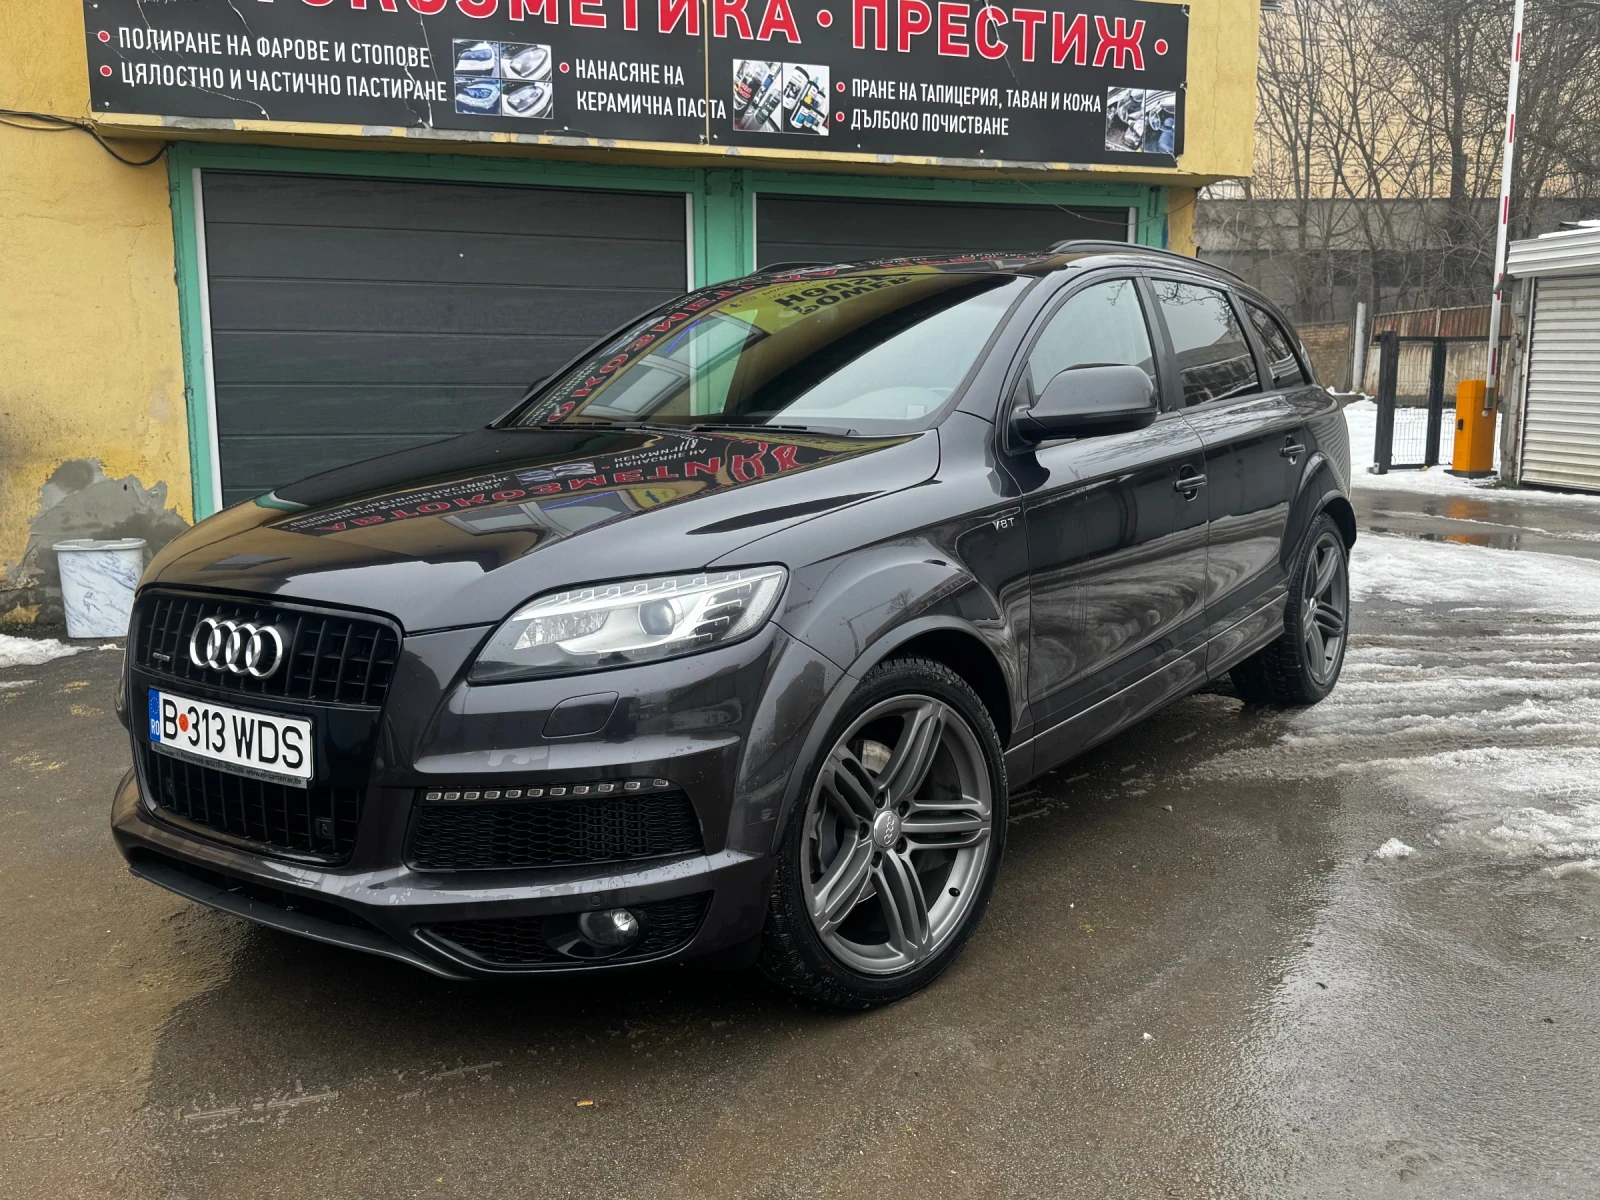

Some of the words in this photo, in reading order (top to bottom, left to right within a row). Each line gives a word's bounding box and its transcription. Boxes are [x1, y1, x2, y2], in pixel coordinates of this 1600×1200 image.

[118, 27, 221, 54] ПОЛИРАНЕ
[227, 34, 251, 56] НА
[256, 37, 329, 62] ФАРОВЕ
[333, 43, 347, 63] И
[351, 44, 430, 68] СТОПОВЕ
[852, 0, 1146, 70] ПРЕСТИЖ
[121, 62, 224, 89] ЦЯЛОСТНО
[230, 69, 242, 90] И
[246, 70, 340, 96] ЧАСТИЧНО
[346, 76, 447, 102] ПАСТИРАНЕ
[576, 59, 659, 85] НАНАСЯНЕ
[664, 66, 684, 86] НА
[576, 91, 673, 116] КЕРАМИЧНА
[677, 98, 727, 120] ПАСТА
[852, 79, 895, 100] ПРАНЕ
[899, 84, 917, 102] НА
[920, 84, 1003, 109] ТАПИЦЕРИЯ,
[1006, 89, 1047, 109] ТАВАН
[1051, 92, 1060, 110] И
[1064, 93, 1101, 113] КОЖА
[851, 109, 919, 131] ДЪЛБОКО
[922, 111, 1009, 136] ПОЧИСТВАНЕ
[992, 518, 1014, 530] V8T
[151, 718, 160, 736] RO
[162, 698, 178, 740] B
[187, 706, 226, 753] 313
[232, 715, 304, 769] WDS
